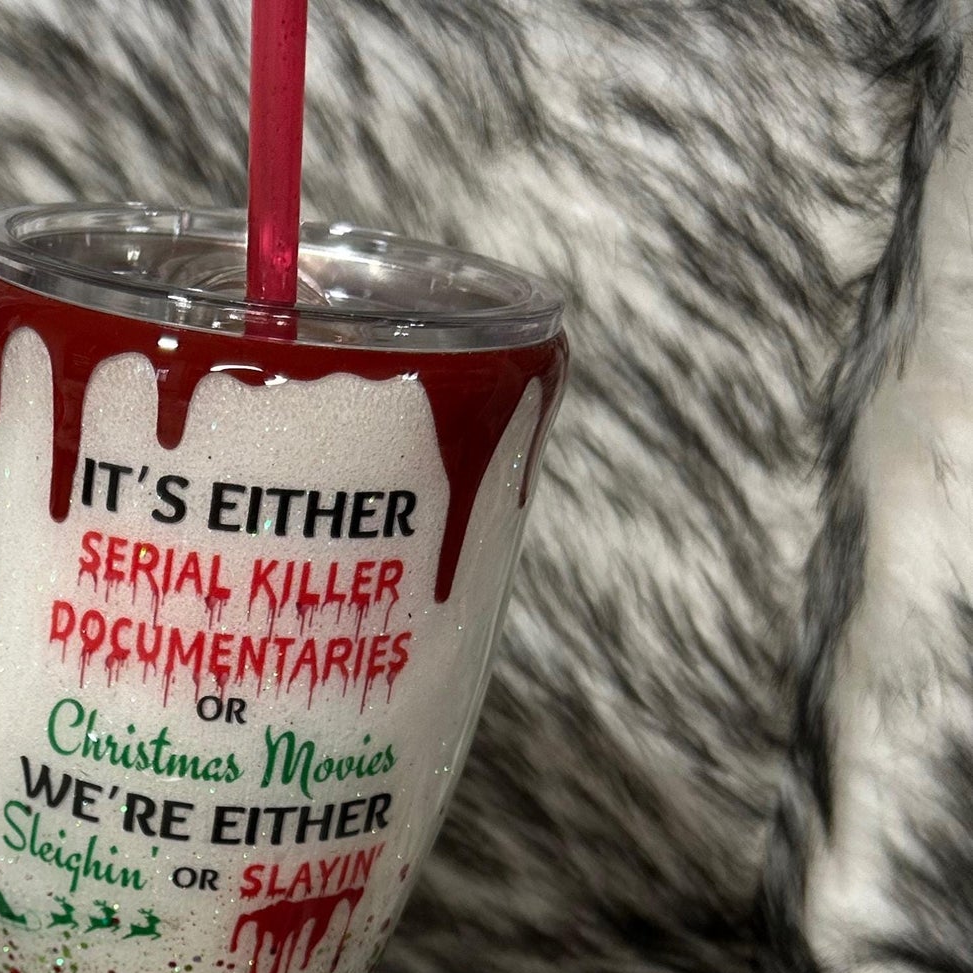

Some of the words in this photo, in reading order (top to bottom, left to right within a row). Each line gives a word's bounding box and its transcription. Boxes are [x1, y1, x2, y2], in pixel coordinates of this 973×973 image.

[81, 457, 189, 525] IT'S
[207, 481, 417, 538] EITHER
[78, 530, 231, 617] SERIAL
[249, 559, 405, 624] KILLER
[48, 600, 412, 698] DOCUMENTARIES
[47, 698, 245, 784] Christmas
[261, 725, 397, 800] Movies
[196, 695, 247, 725] OR
[20, 755, 191, 841] WE'RE
[210, 792, 393, 846] EITHER
[2, 799, 159, 893] Sleighin'
[172, 866, 219, 891] OR
[239, 842, 385, 898] SLAYIN'
